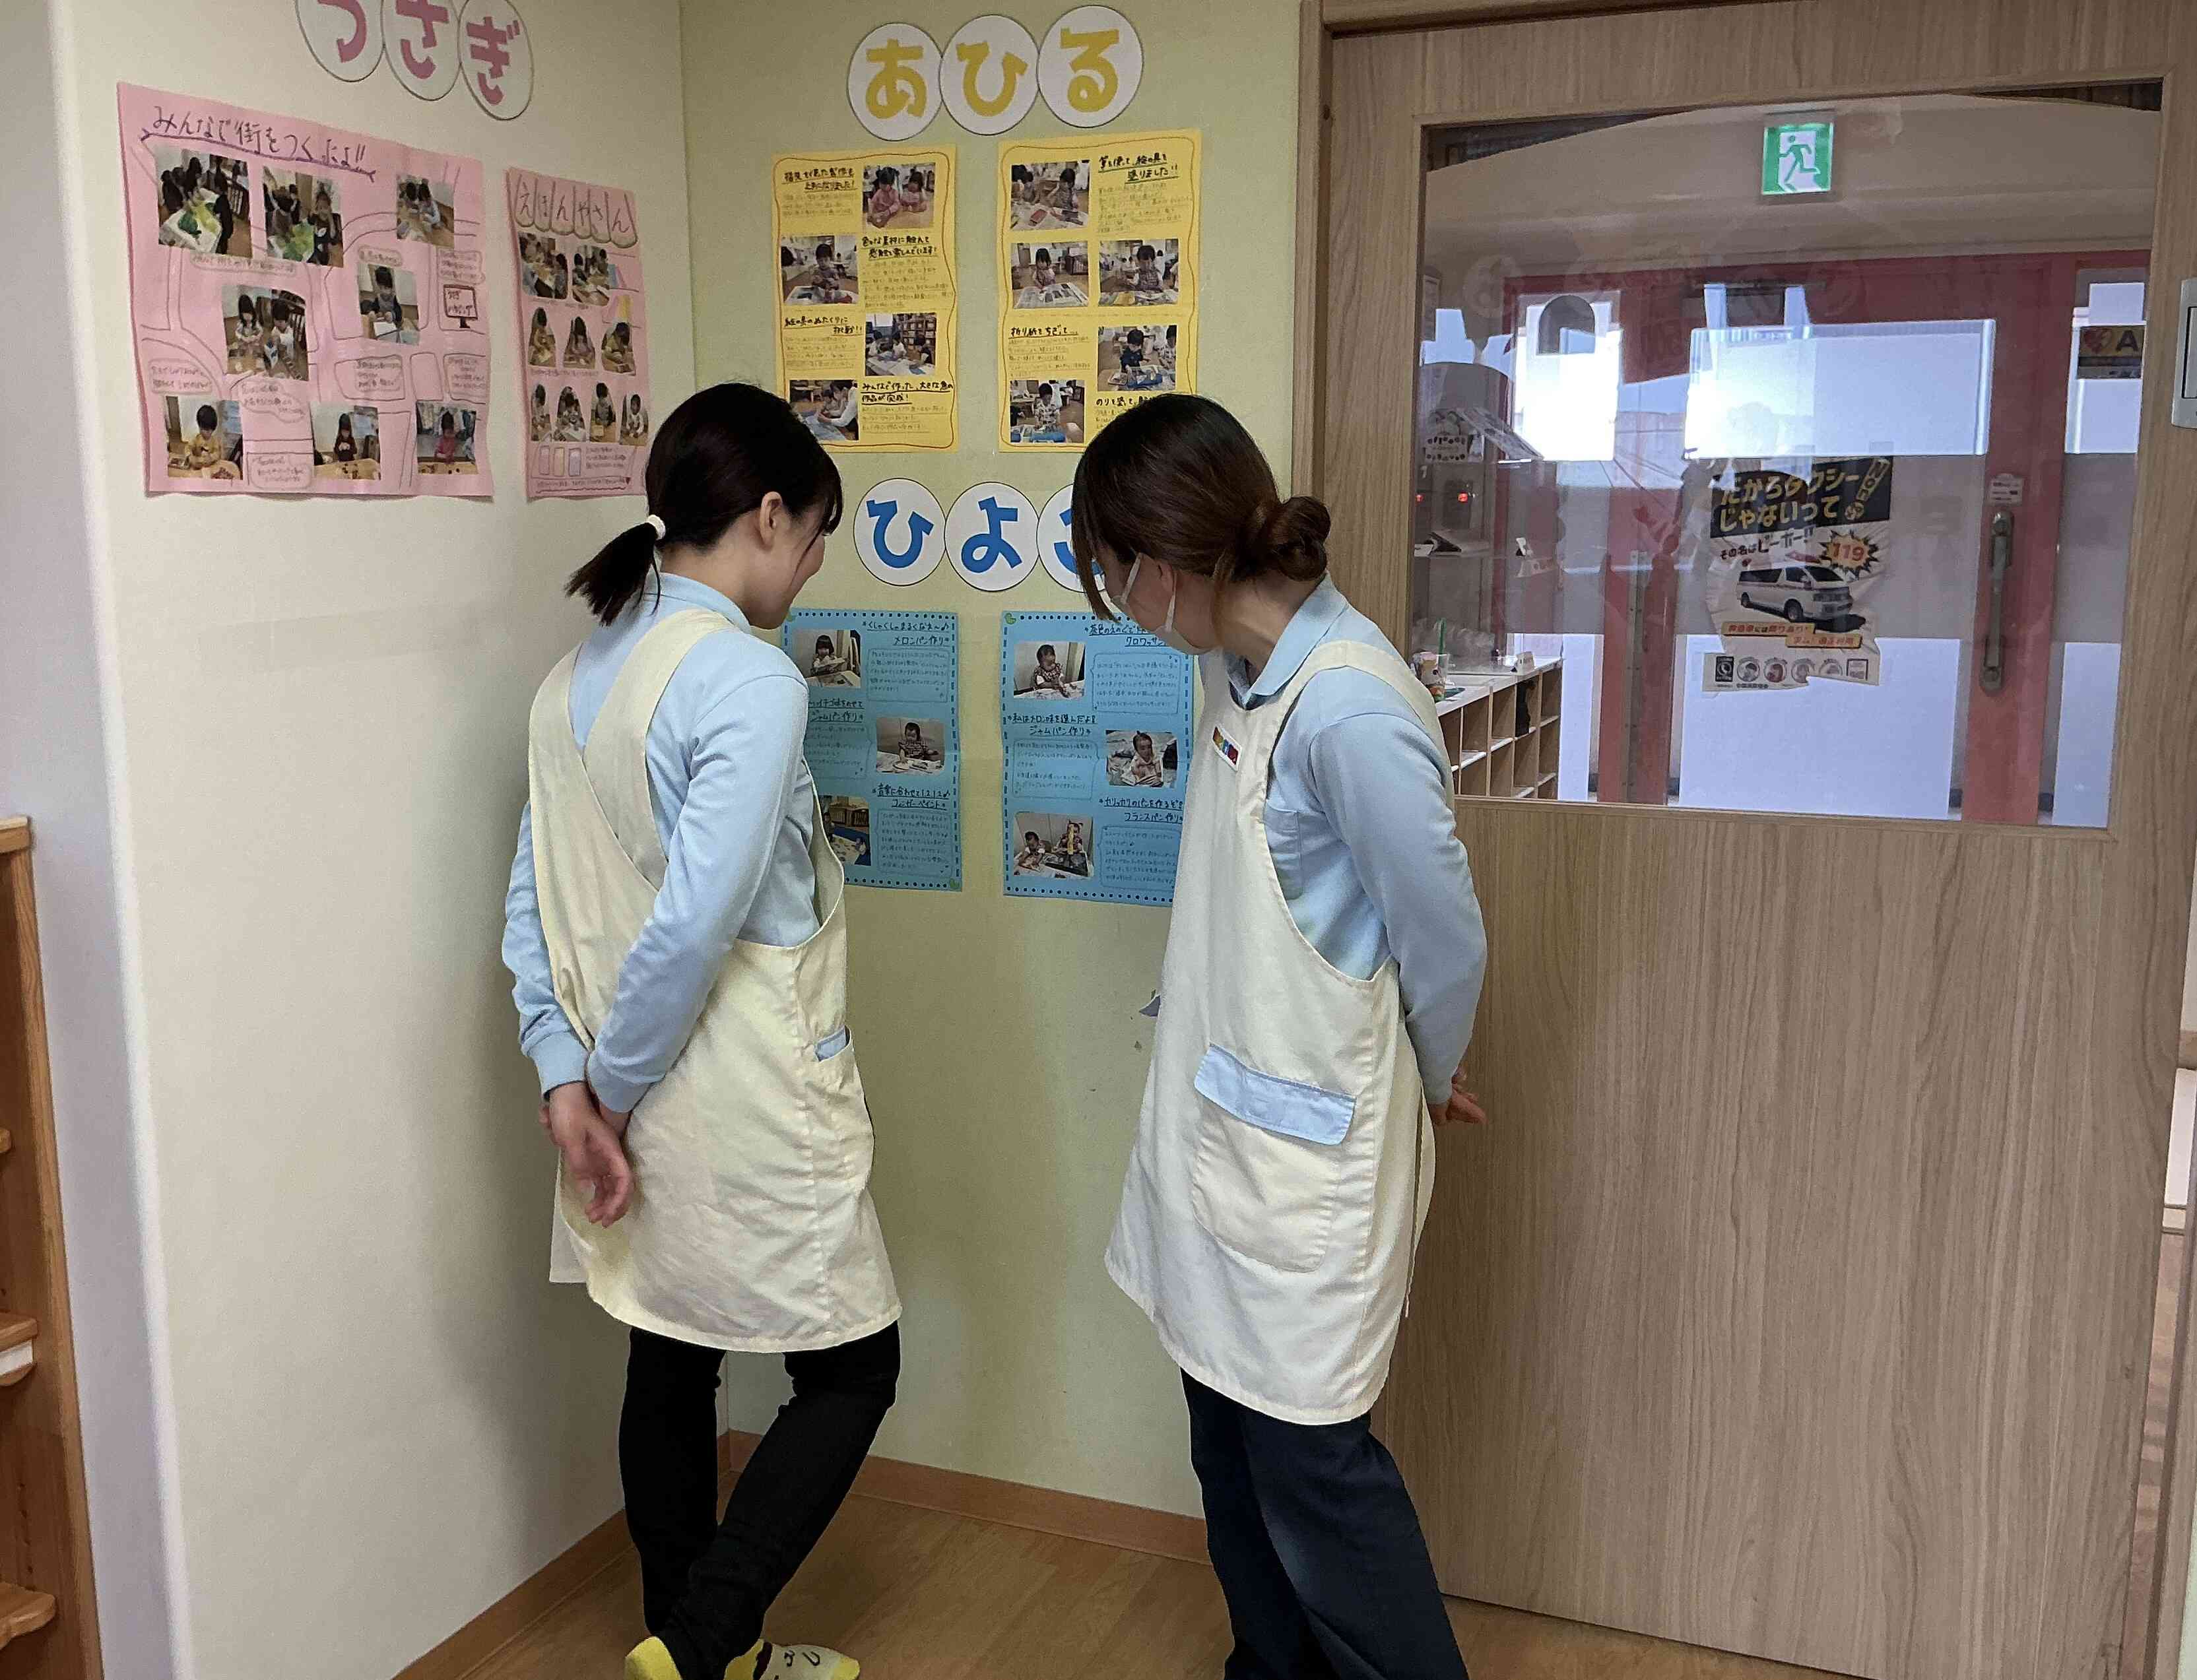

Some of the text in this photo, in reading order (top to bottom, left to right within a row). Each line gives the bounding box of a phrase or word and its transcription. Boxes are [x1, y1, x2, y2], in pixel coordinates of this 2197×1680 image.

[866, 27, 1119, 119] あひる
[1832, 542, 1864, 562] 119
